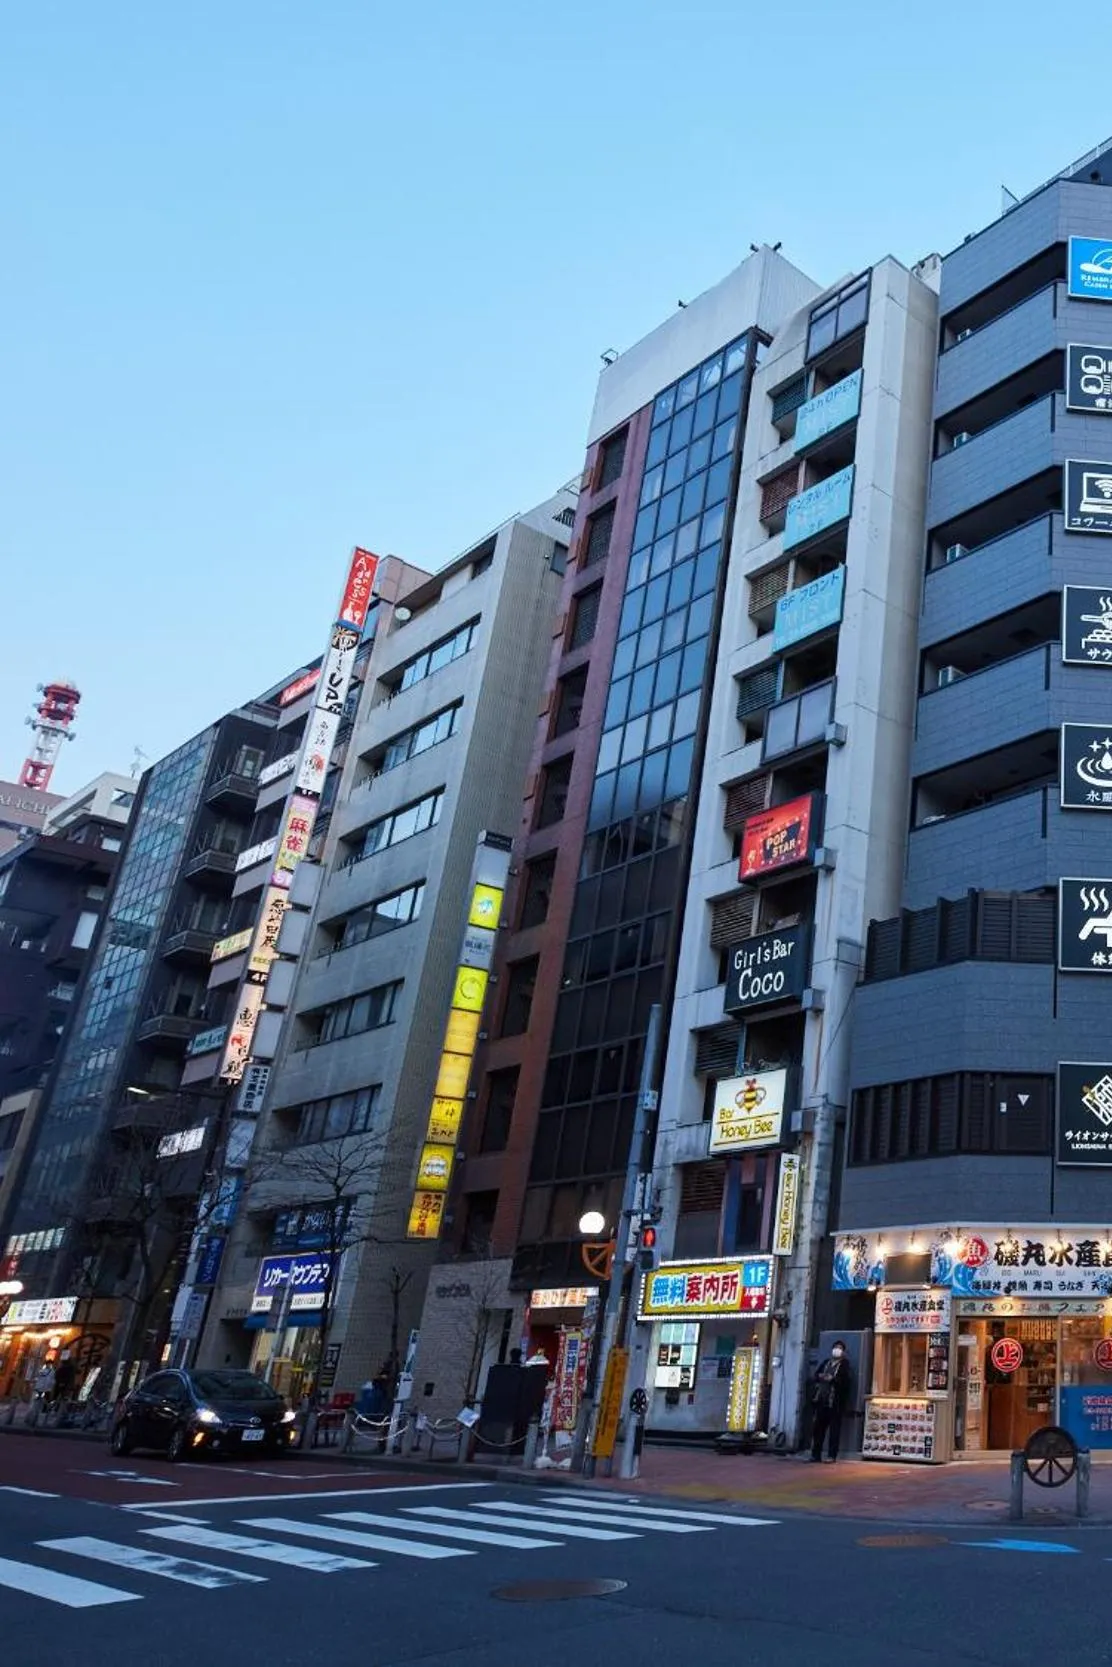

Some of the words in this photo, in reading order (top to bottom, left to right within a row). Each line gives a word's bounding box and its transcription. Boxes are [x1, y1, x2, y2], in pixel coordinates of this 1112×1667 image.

[766, 830, 788, 849] POP
[772, 841, 796, 859] STAR
[734, 941, 770, 970] Girl's
[773, 938, 795, 958] Bar
[719, 1107, 735, 1120] Bar
[720, 1122, 752, 1139] Honey
[754, 1119, 774, 1133] Bee
[748, 1267, 767, 1283] 1F
[651, 1270, 740, 1306] 無料案内所
[1058, 1279, 1085, 1291] うなぎ
